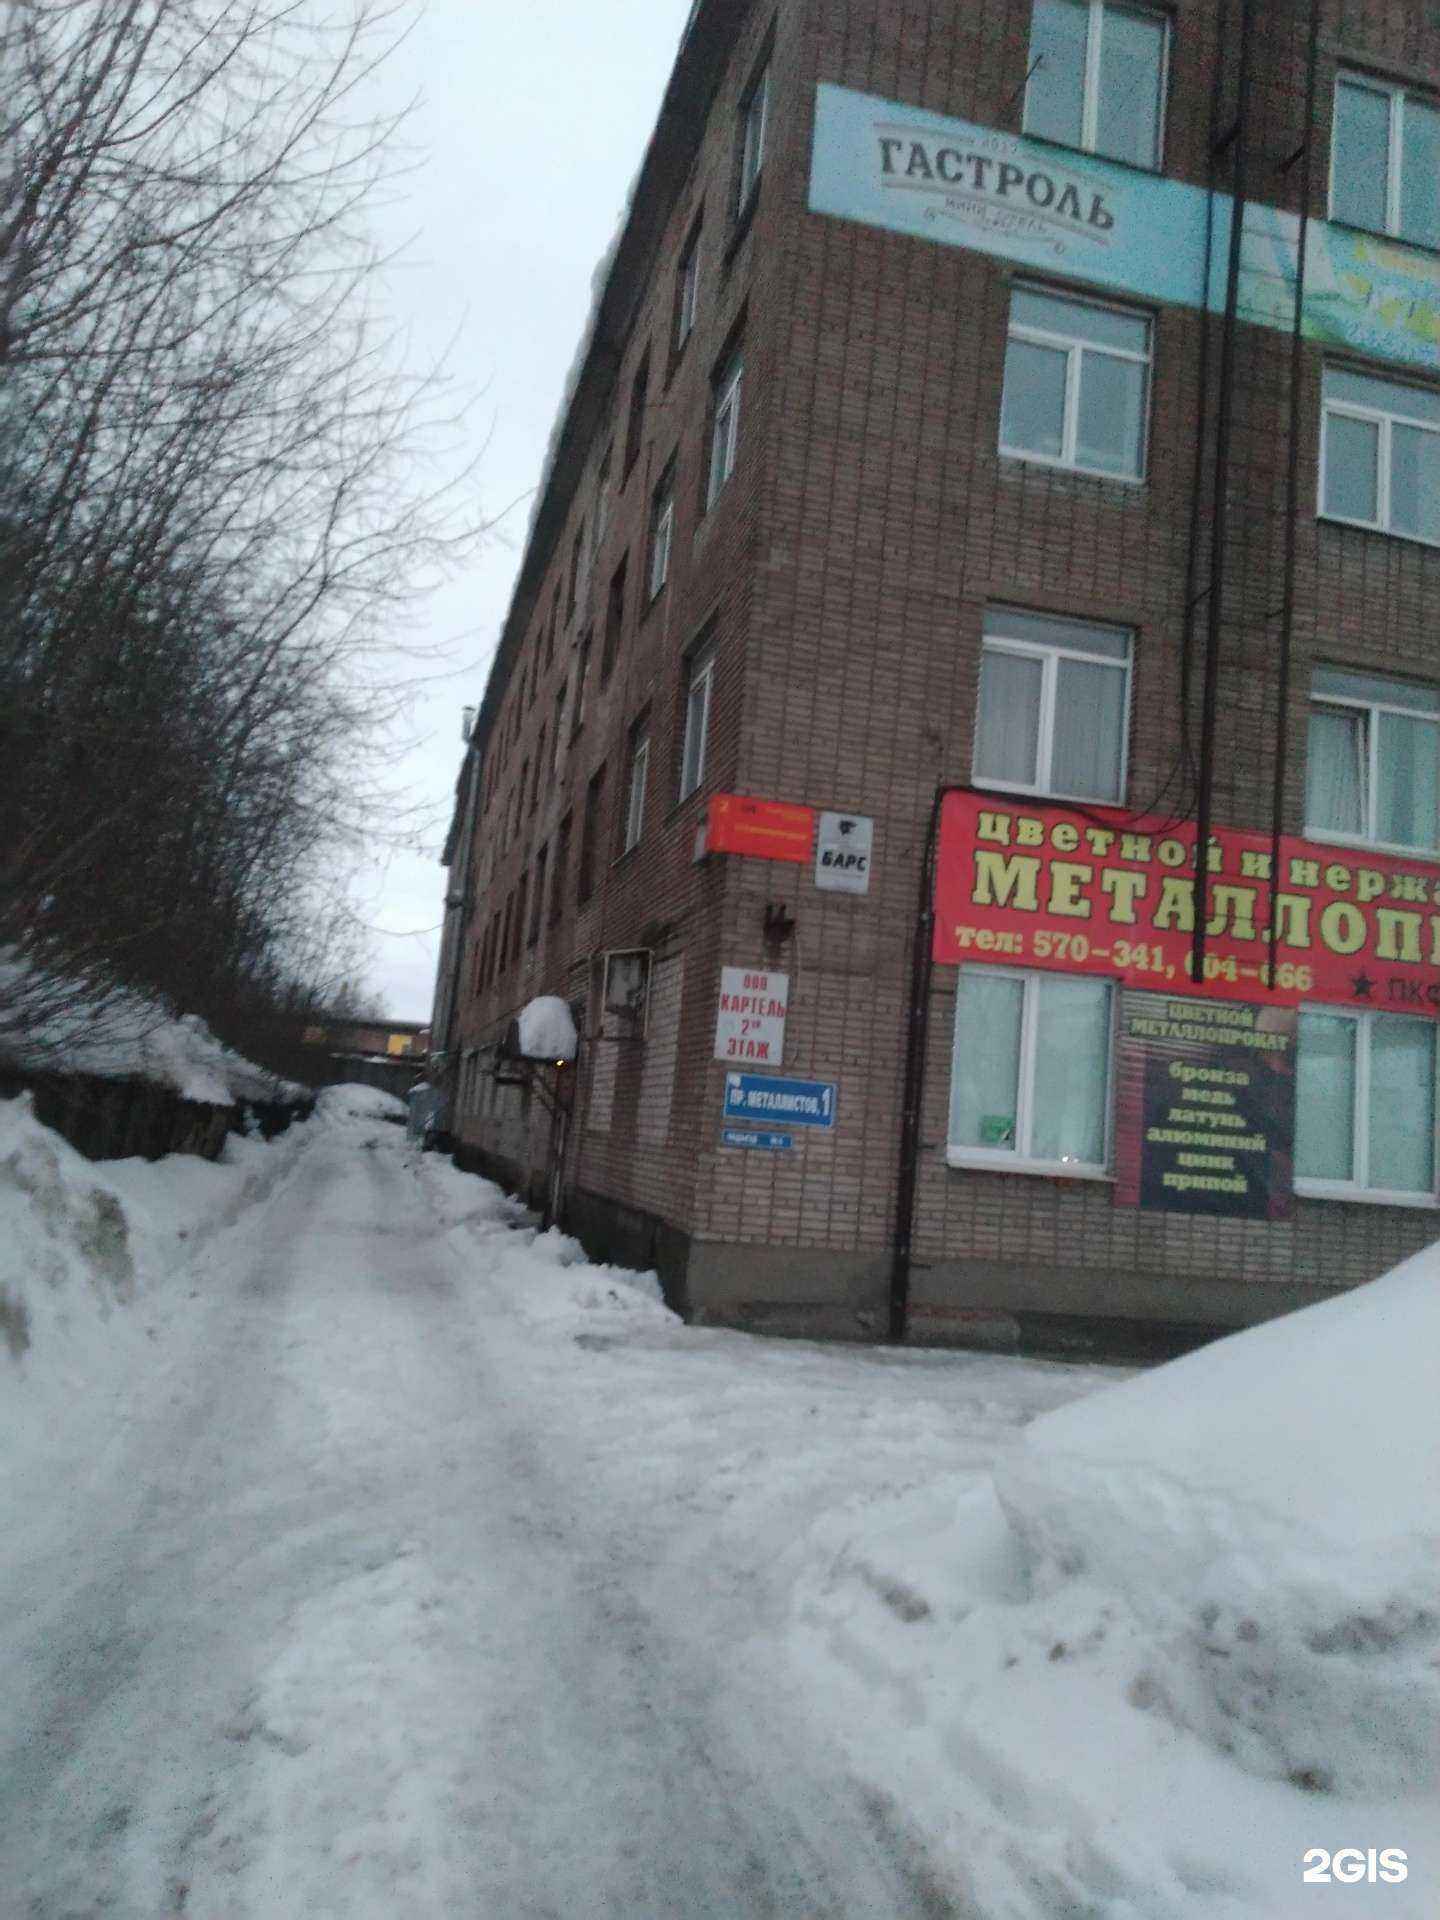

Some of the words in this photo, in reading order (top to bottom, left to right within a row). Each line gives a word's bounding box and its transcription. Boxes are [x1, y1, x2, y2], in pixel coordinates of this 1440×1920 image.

[878, 137, 1115, 231] ГАСТРОЛЬ
[821, 851, 867, 872] БАРС
[977, 812, 1222, 872] цветной
[1240, 851, 1272, 880] и
[1289, 858, 1440, 907] нерж
[971, 849, 1440, 967] МЕТАЛЛОП
[955, 926, 1024, 954] тел:
[1033, 930, 1176, 980] 570-341,
[743, 974, 768, 992] ООО
[720, 993, 787, 1018] КАРТЕЛЬ
[726, 1037, 770, 1060] ЭТАЖ
[1169, 1061, 1249, 1086] бронза
[821, 1087, 831, 1117] 1
